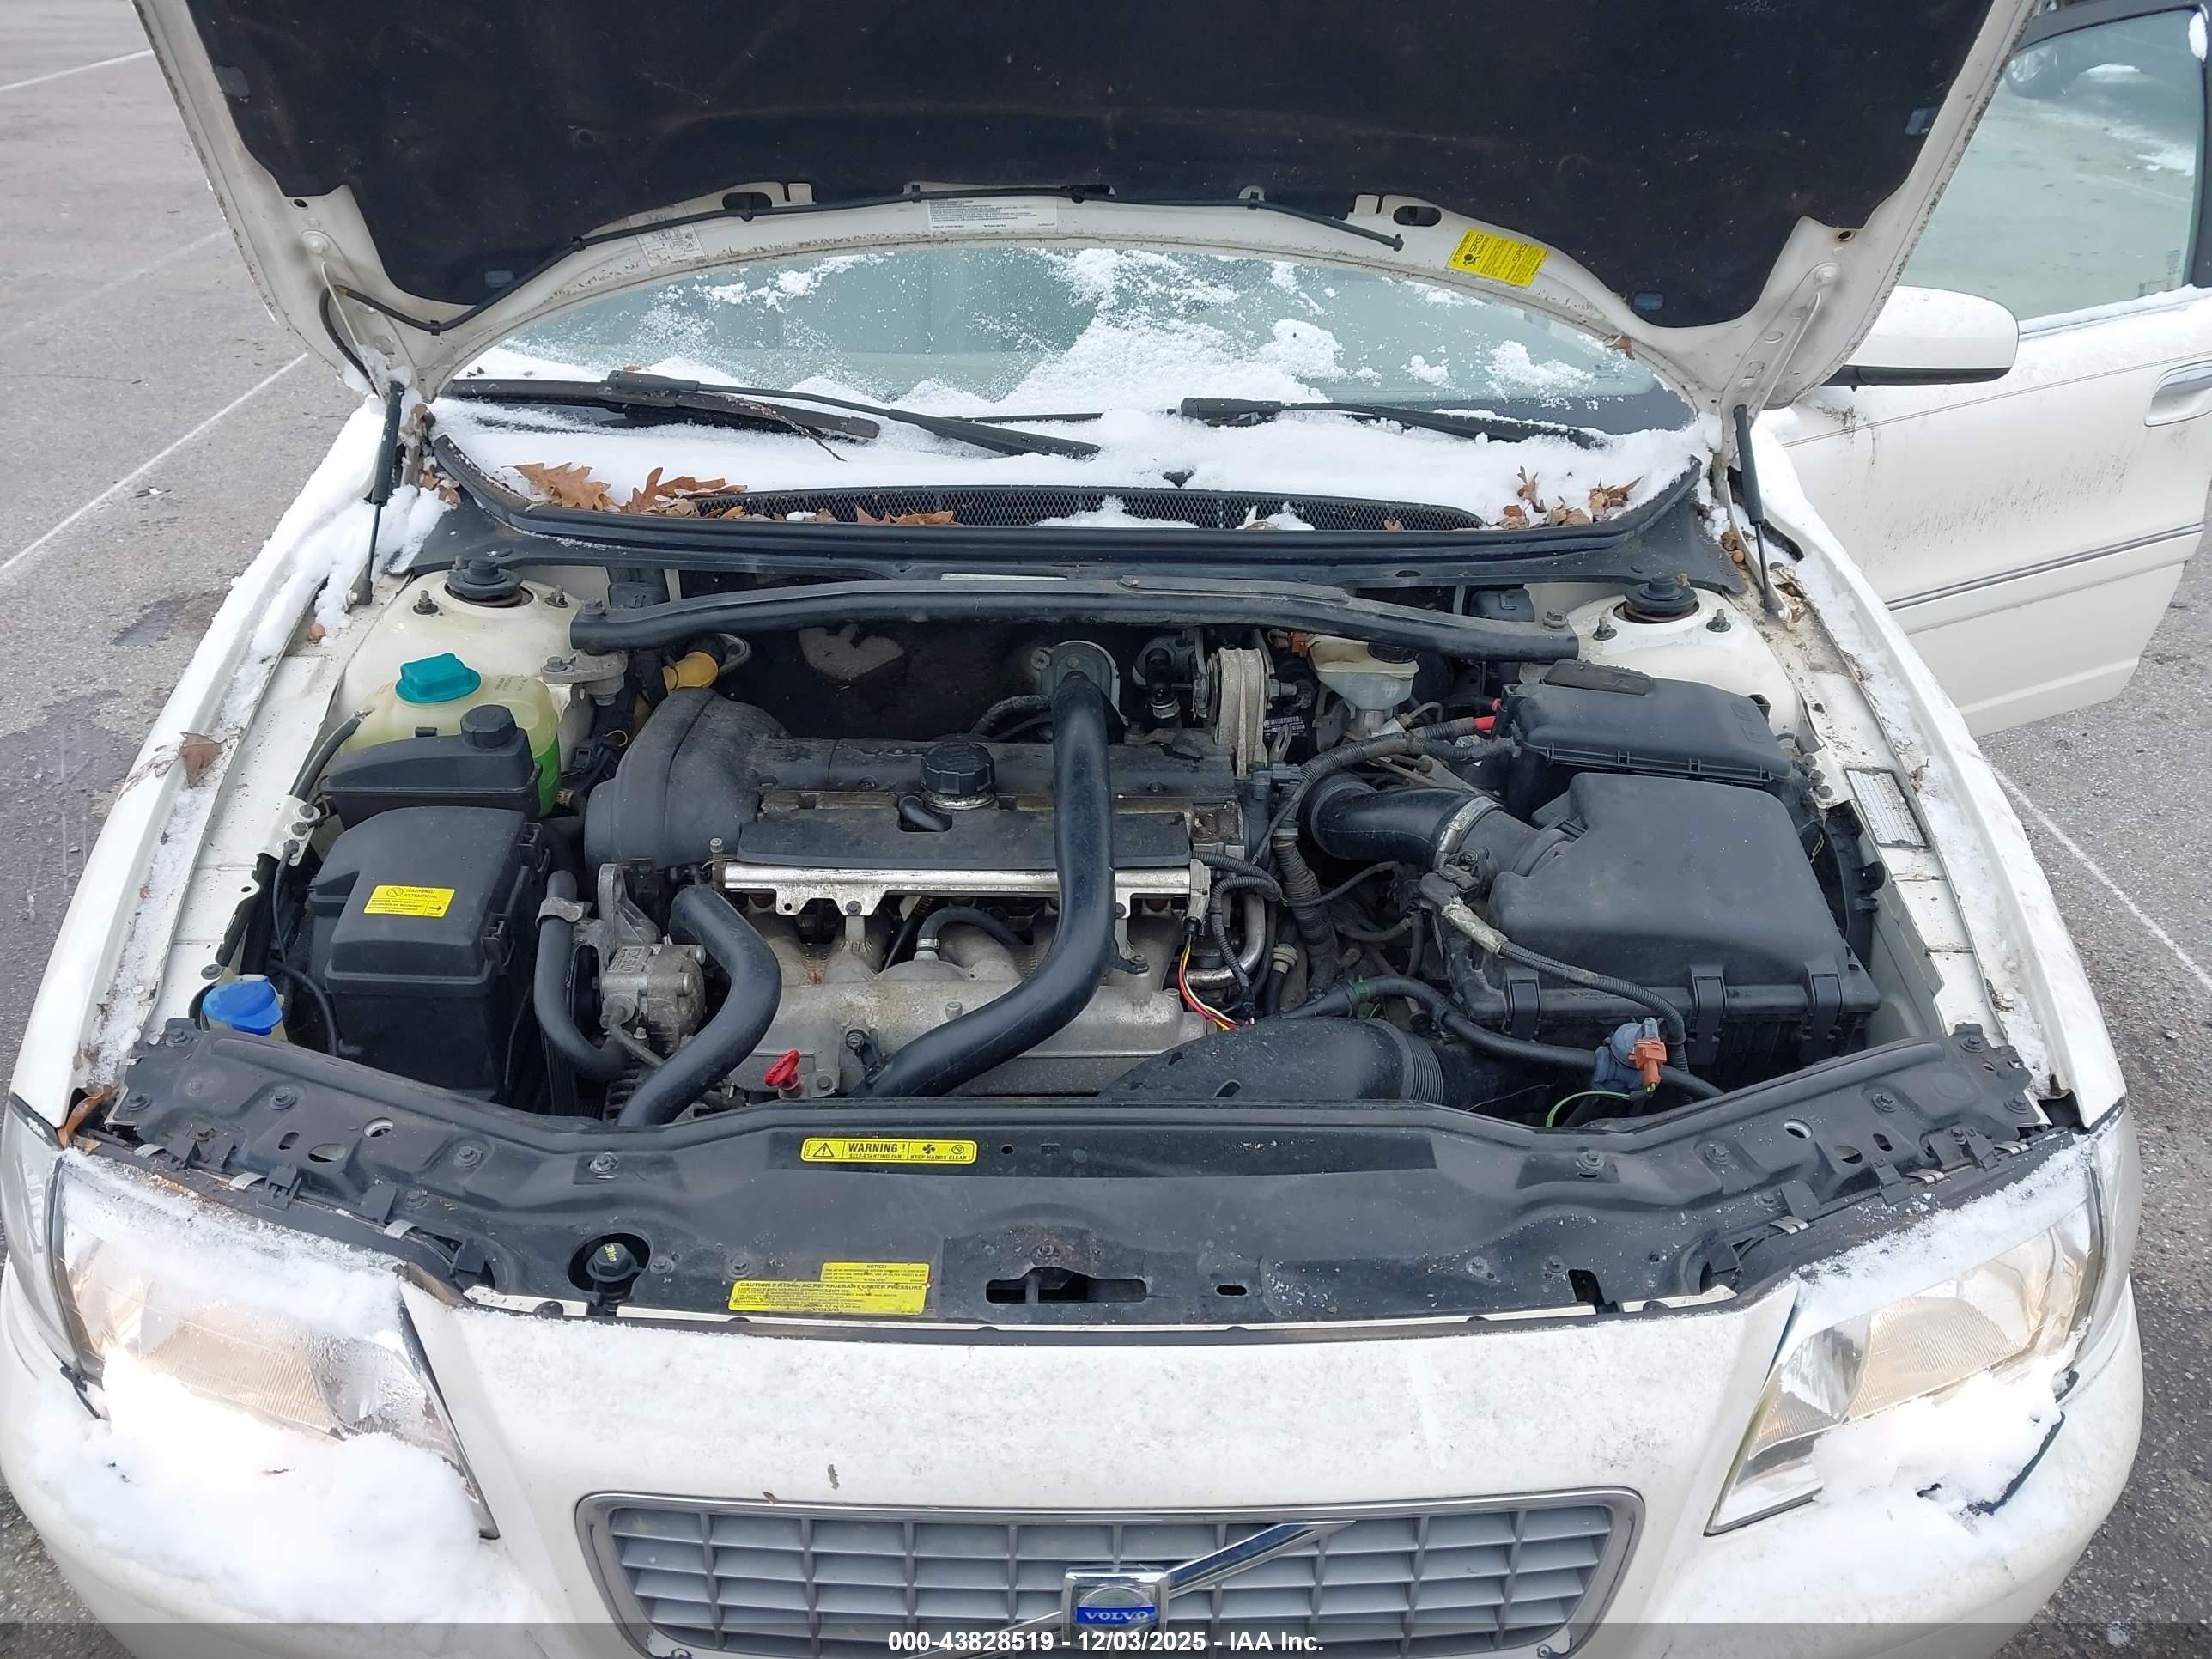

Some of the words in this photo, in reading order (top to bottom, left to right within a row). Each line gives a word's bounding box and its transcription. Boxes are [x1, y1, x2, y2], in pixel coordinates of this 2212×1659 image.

[1469, 234, 1484, 252] SRS
[1513, 242, 1528, 262] SRS
[848, 1142, 897, 1152] WARNING
[902, 1144, 906, 1152] !
[1085, 1611, 1147, 1620] VOLVO
